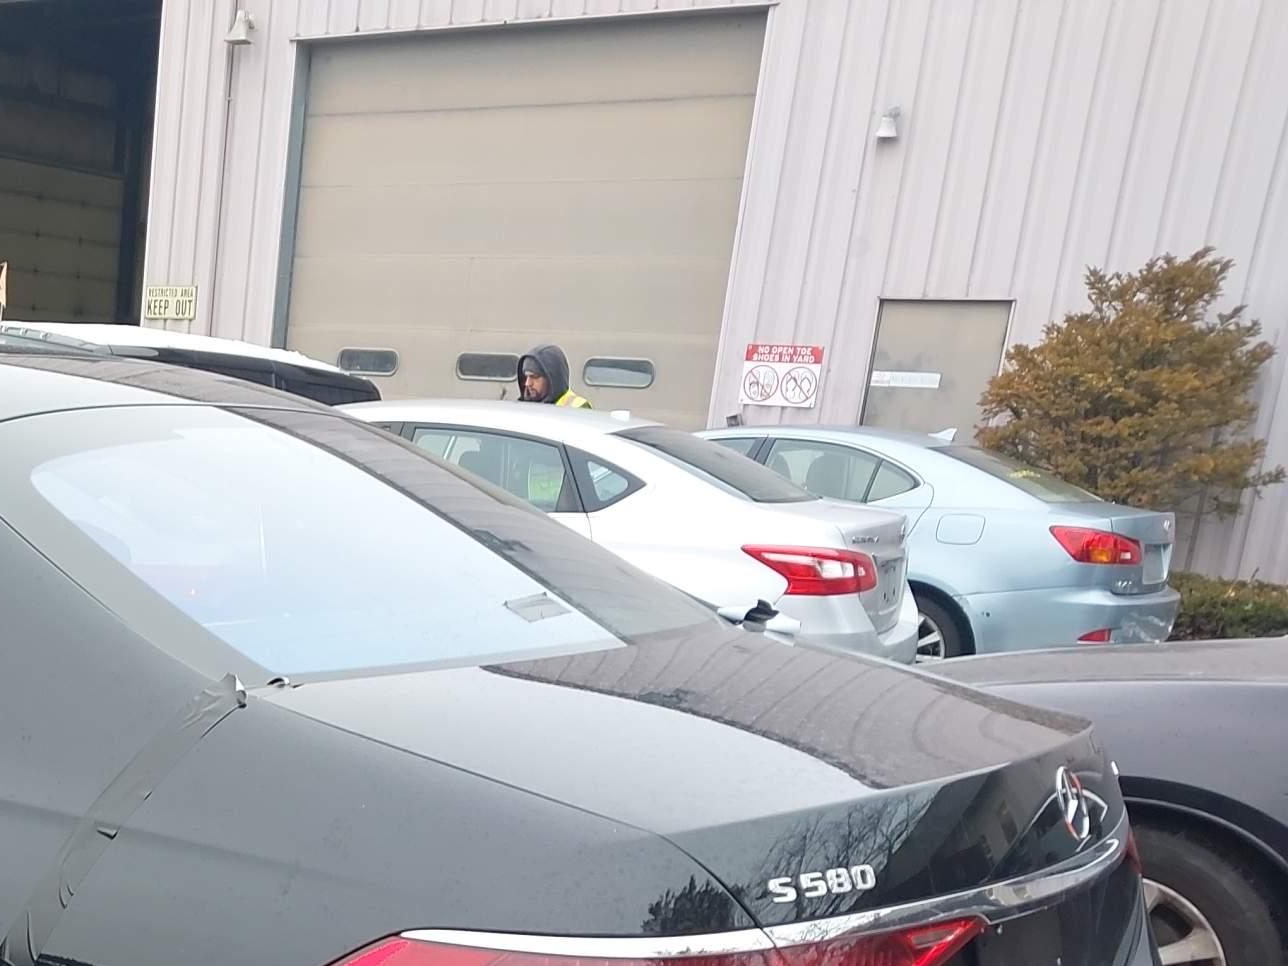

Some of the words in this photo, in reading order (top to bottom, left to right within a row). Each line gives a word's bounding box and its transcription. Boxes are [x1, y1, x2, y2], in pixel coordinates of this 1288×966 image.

[147, 299, 169, 316] KEEP
[175, 299, 193, 316] OUT
[758, 346, 770, 354] NO
[771, 346, 794, 355] OPEN
[796, 347, 813, 356] TOE
[752, 353, 780, 362] SHOES
[781, 354, 792, 362] IN
[793, 355, 815, 363] YARD
[768, 877, 797, 903] S
[800, 864, 876, 897] 580
